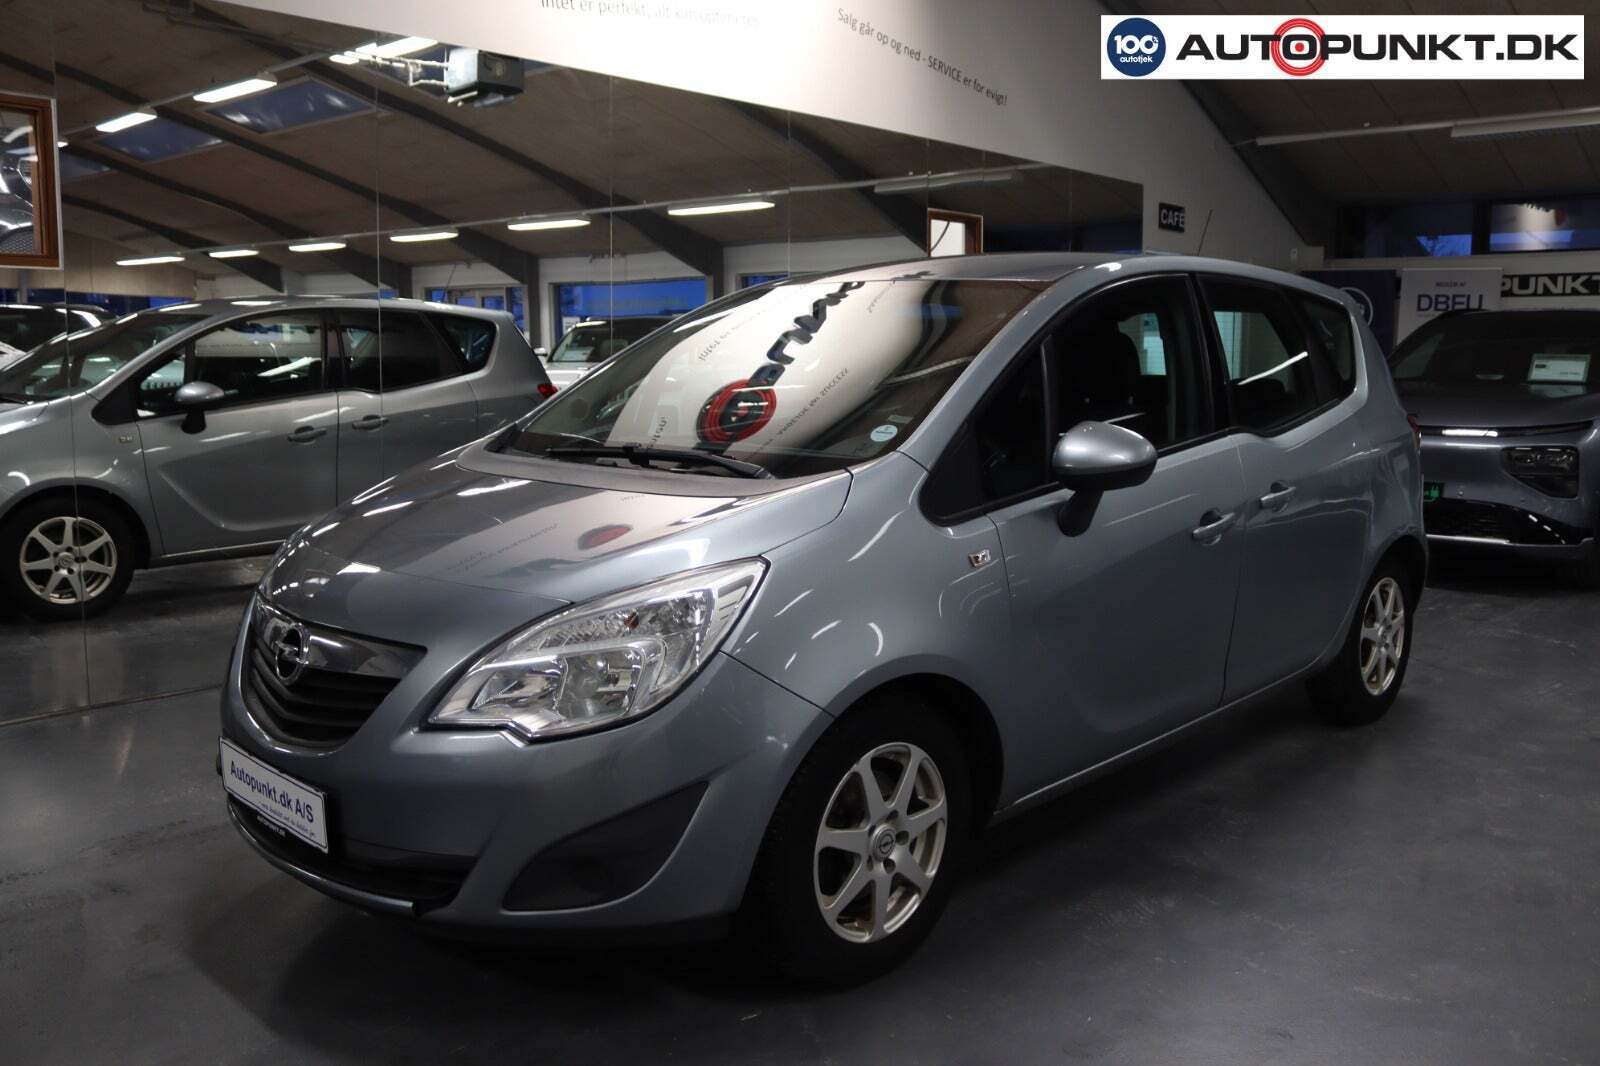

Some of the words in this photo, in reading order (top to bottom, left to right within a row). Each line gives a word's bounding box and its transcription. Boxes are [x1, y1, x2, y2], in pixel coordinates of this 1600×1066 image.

[838, 8, 858, 31] Salg
[859, 21, 875, 36] går
[876, 31, 889, 45] op
[890, 38, 902, 54] og
[903, 45, 921, 61] ned
[928, 55, 961, 82] SERVICE
[963, 76, 971, 88] er
[1501, 274, 1600, 297] UNK
[230, 760, 293, 811] Autopunkt.dk
[295, 798, 314, 823] A/S
